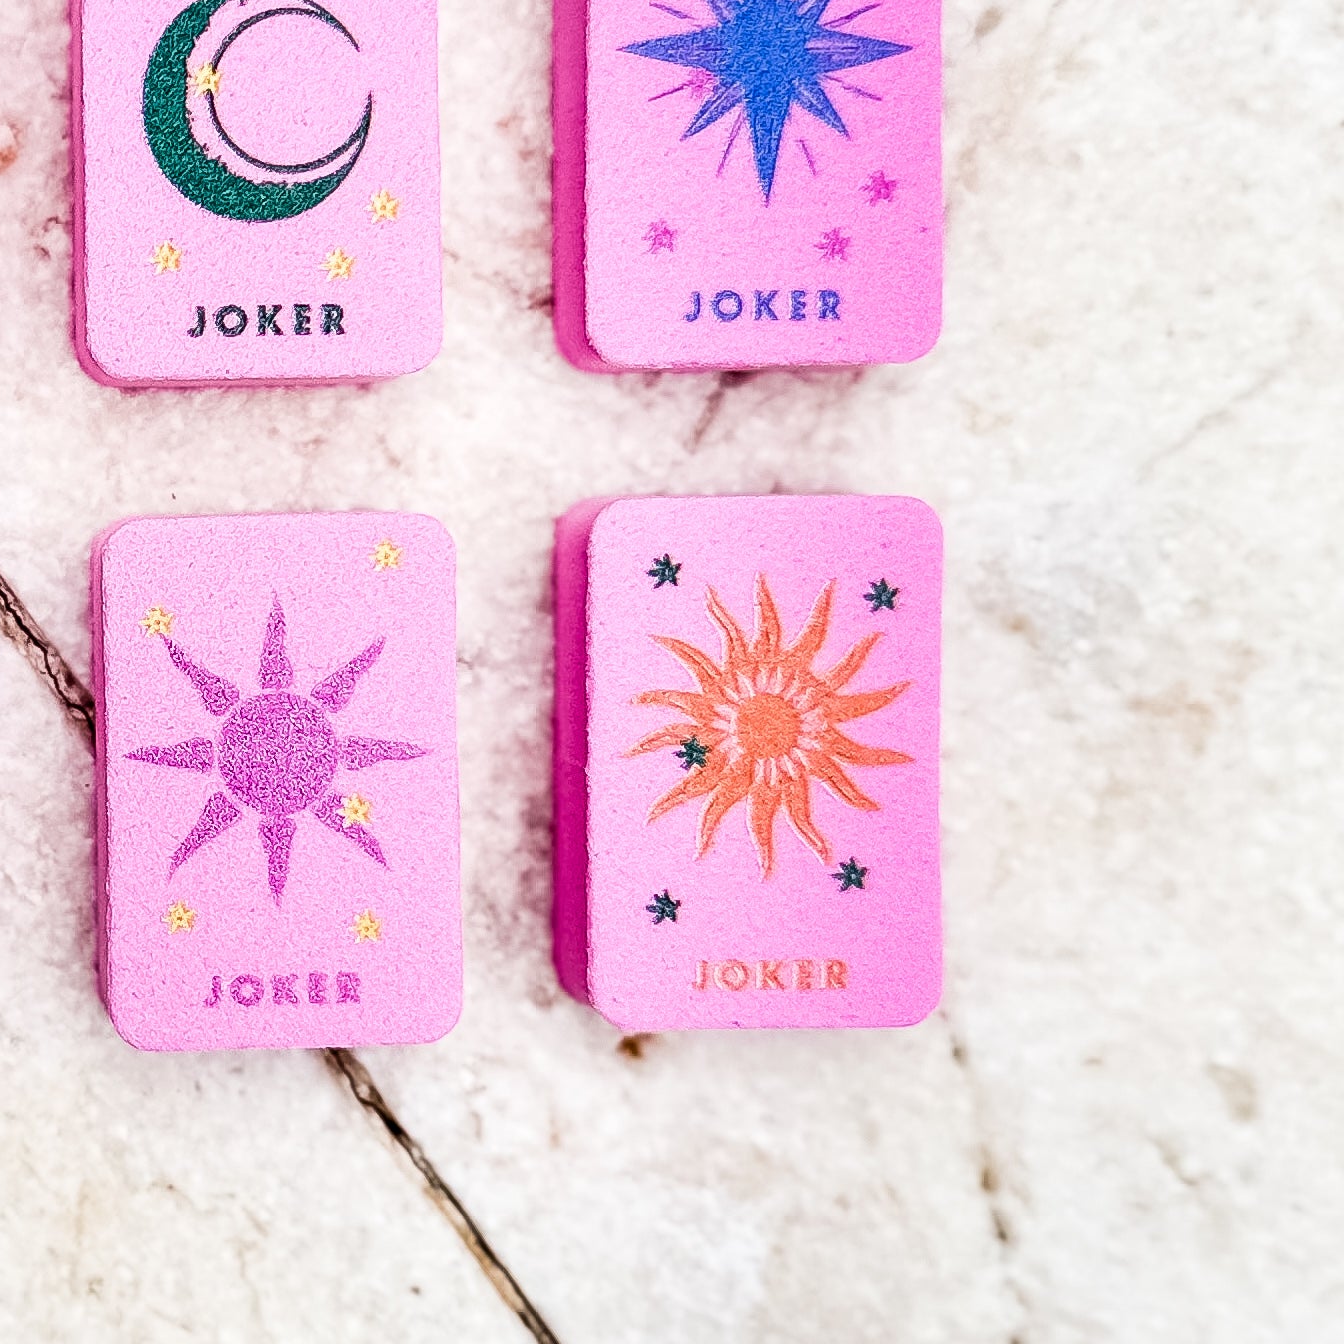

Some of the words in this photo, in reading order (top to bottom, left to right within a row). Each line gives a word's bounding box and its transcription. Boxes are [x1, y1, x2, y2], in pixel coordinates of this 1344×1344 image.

[187, 303, 347, 338] JOKER
[685, 290, 843, 322] JOKER
[203, 972, 361, 1007] JOKER
[691, 958, 848, 991] JOKER
